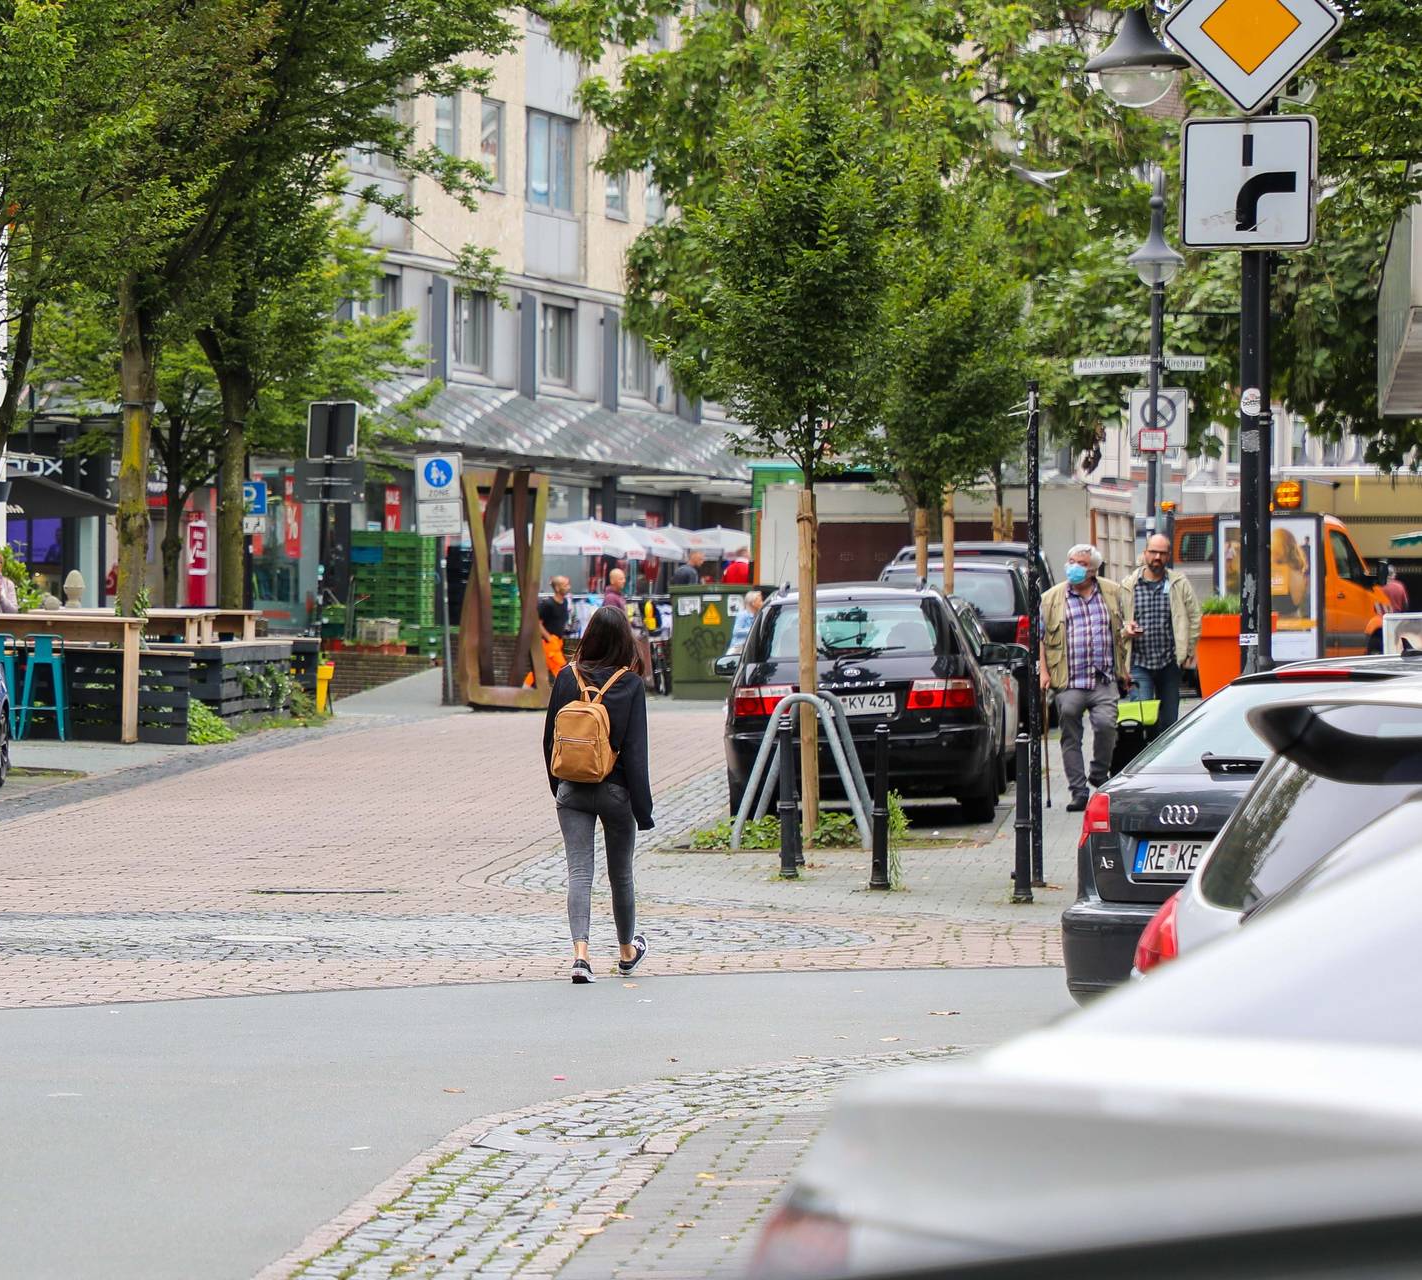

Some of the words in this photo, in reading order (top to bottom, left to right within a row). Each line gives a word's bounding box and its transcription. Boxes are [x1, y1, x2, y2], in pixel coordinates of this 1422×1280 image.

[1165, 360, 1204, 369] Kirchplatz
[428, 490, 450, 498] ZONE
[848, 696, 866, 710] KY
[869, 694, 894, 708] 421
[1100, 856, 1115, 869] A3
[1144, 844, 1169, 871] RE
[1175, 844, 1202, 871] KE
